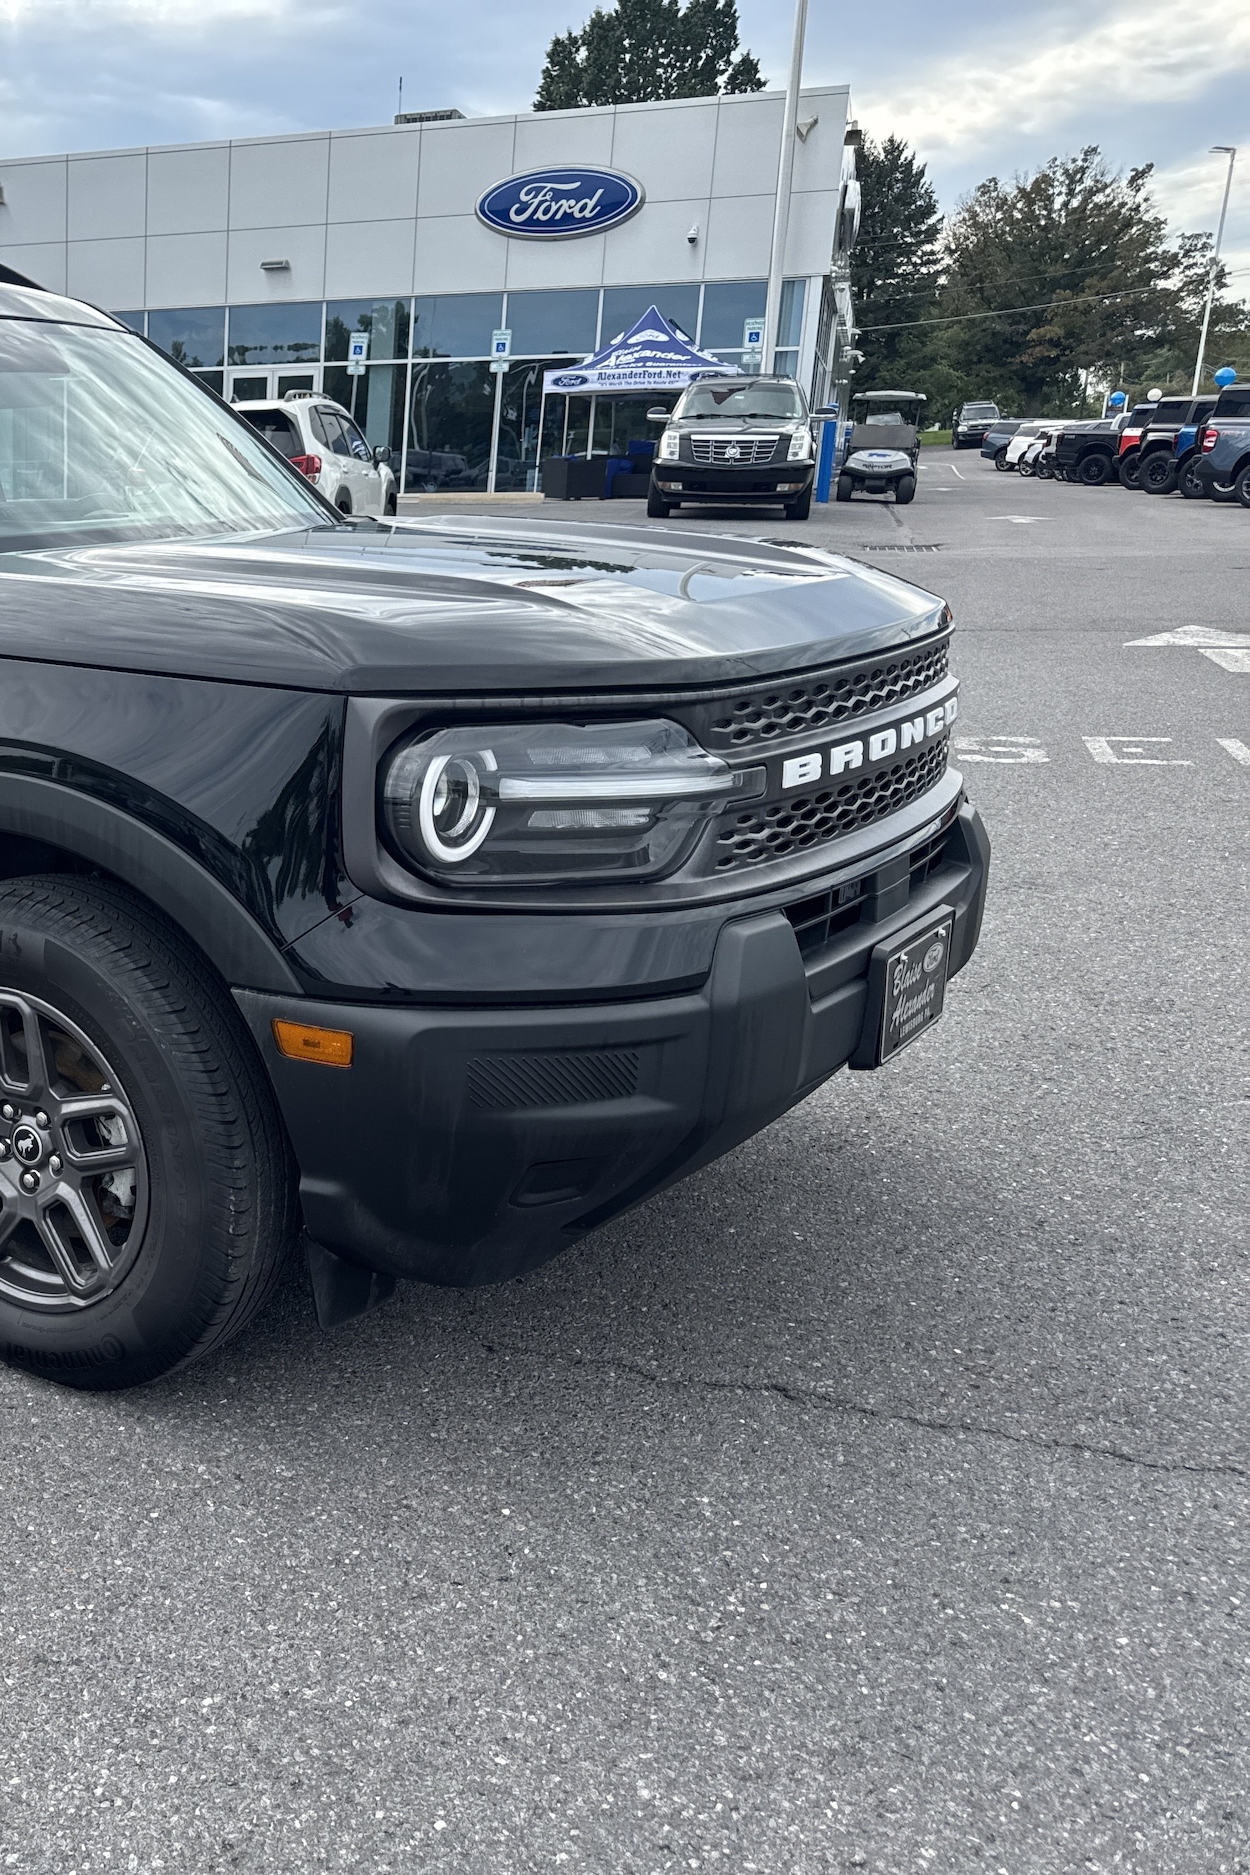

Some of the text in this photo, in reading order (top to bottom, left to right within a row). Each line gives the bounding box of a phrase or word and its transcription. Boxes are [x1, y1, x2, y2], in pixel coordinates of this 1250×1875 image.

[509, 181, 605, 223] Ford
[597, 350, 692, 368] Alexander
[558, 375, 583, 387] Ford
[596, 370, 682, 381] AlexanderFord.Net
[782, 697, 958, 790] BRONCO
[893, 961, 922, 997] Blaise
[890, 978, 935, 1033] Alexander
[900, 1011, 924, 1038] LEWISBURG
